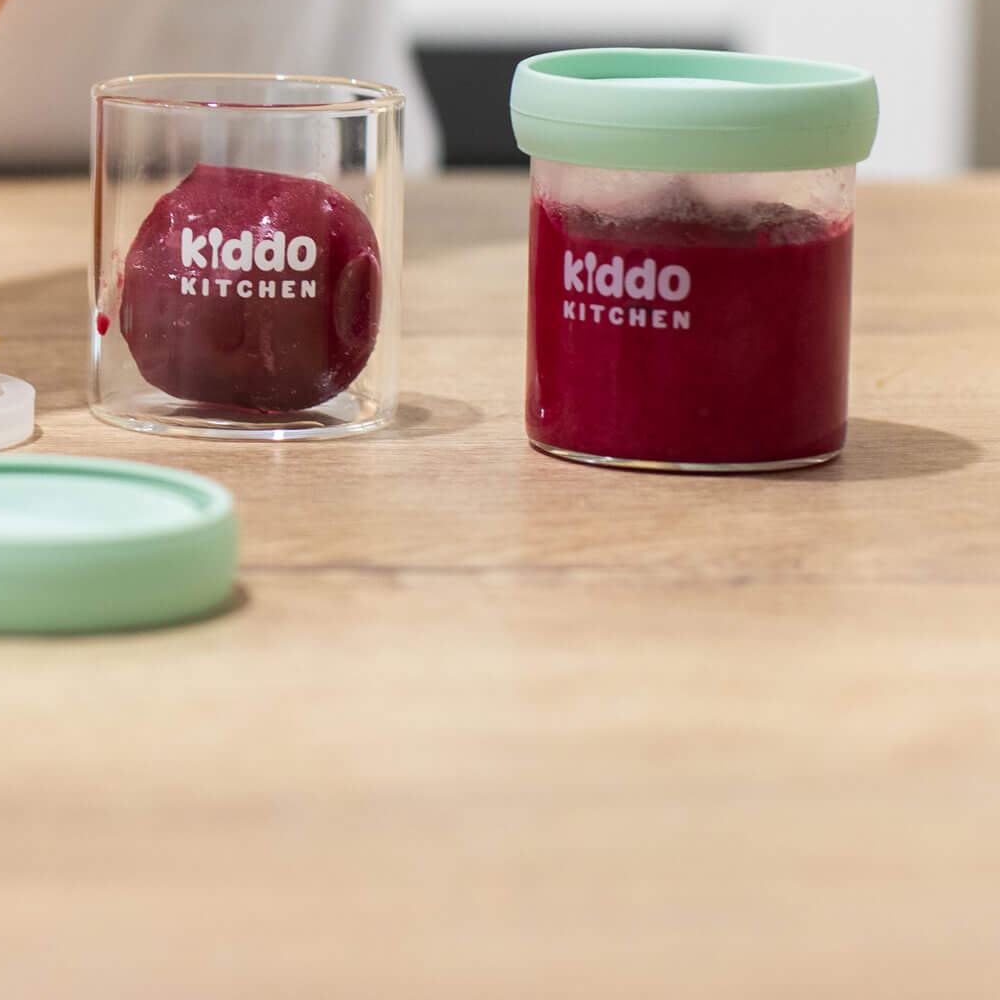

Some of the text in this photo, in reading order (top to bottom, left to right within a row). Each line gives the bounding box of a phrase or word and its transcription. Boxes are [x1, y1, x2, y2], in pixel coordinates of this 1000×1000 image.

[181, 227, 317, 272] kiddo
[181, 276, 317, 299] KITCHEN
[563, 250, 691, 302] kiddo
[563, 300, 691, 329] KITCHEN
